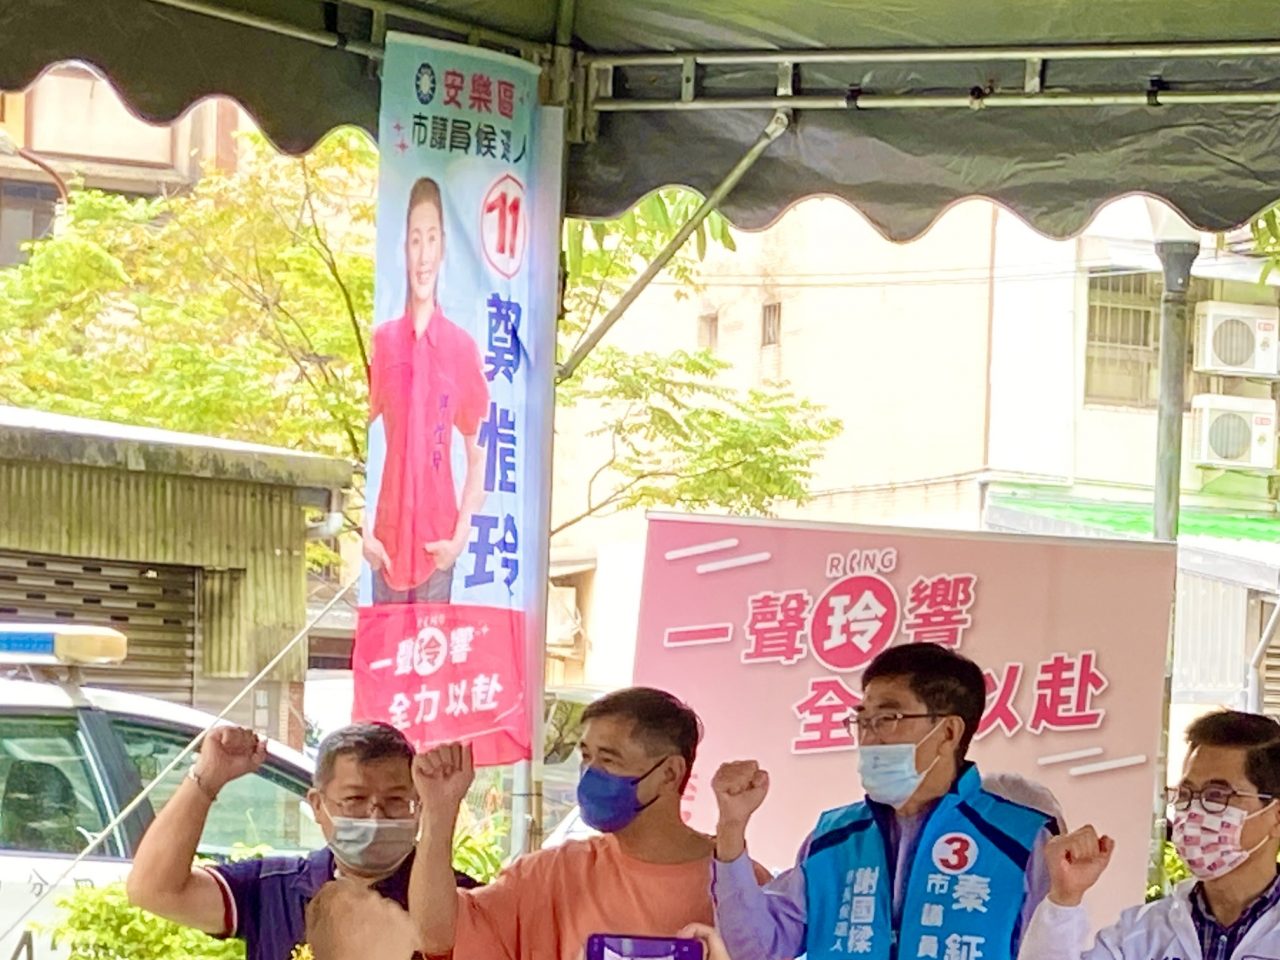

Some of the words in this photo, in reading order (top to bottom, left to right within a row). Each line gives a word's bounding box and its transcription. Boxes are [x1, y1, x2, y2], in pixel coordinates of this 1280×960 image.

[441, 70, 517, 120] 安樂區
[486, 191, 521, 259] 11
[664, 573, 978, 672] 一聲玲響
[388, 673, 503, 730] 全力以赴
[938, 836, 971, 871] 3
